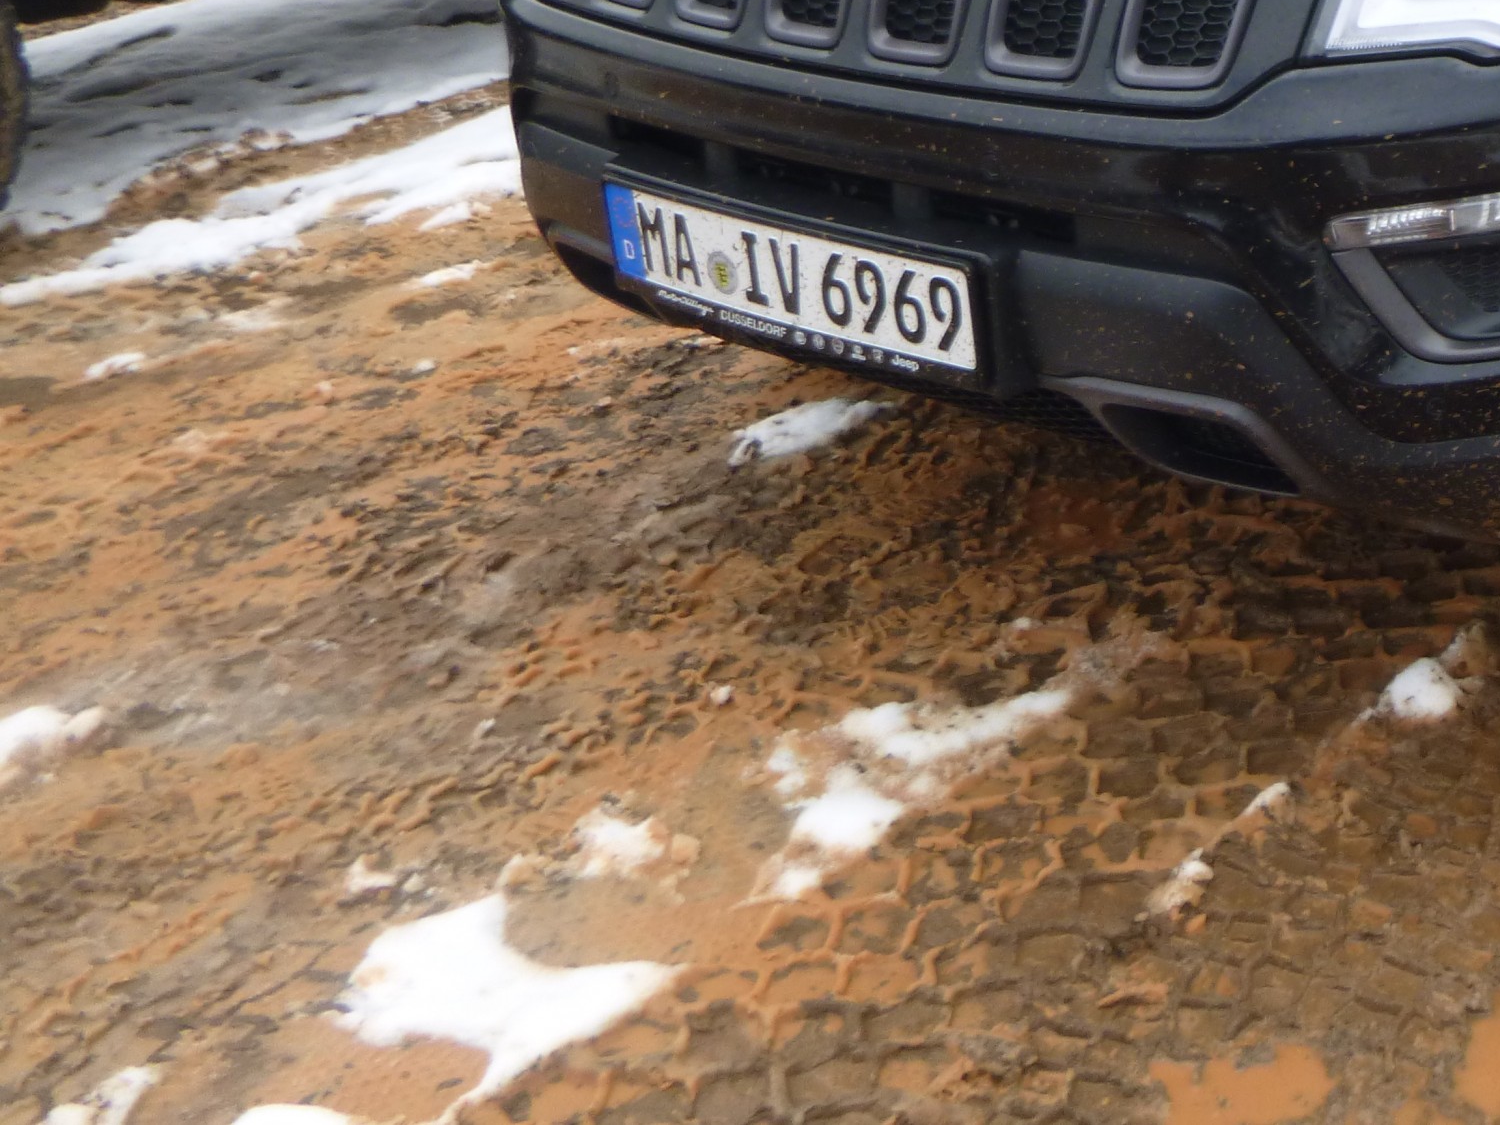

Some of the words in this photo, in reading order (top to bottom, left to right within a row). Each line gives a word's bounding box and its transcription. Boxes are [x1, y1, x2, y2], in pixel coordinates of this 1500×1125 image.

[623, 238, 635, 260] D
[637, 201, 702, 287] MA
[741, 230, 799, 315] IV
[822, 252, 961, 352] 6969
[891, 354, 919, 372] Jeep
